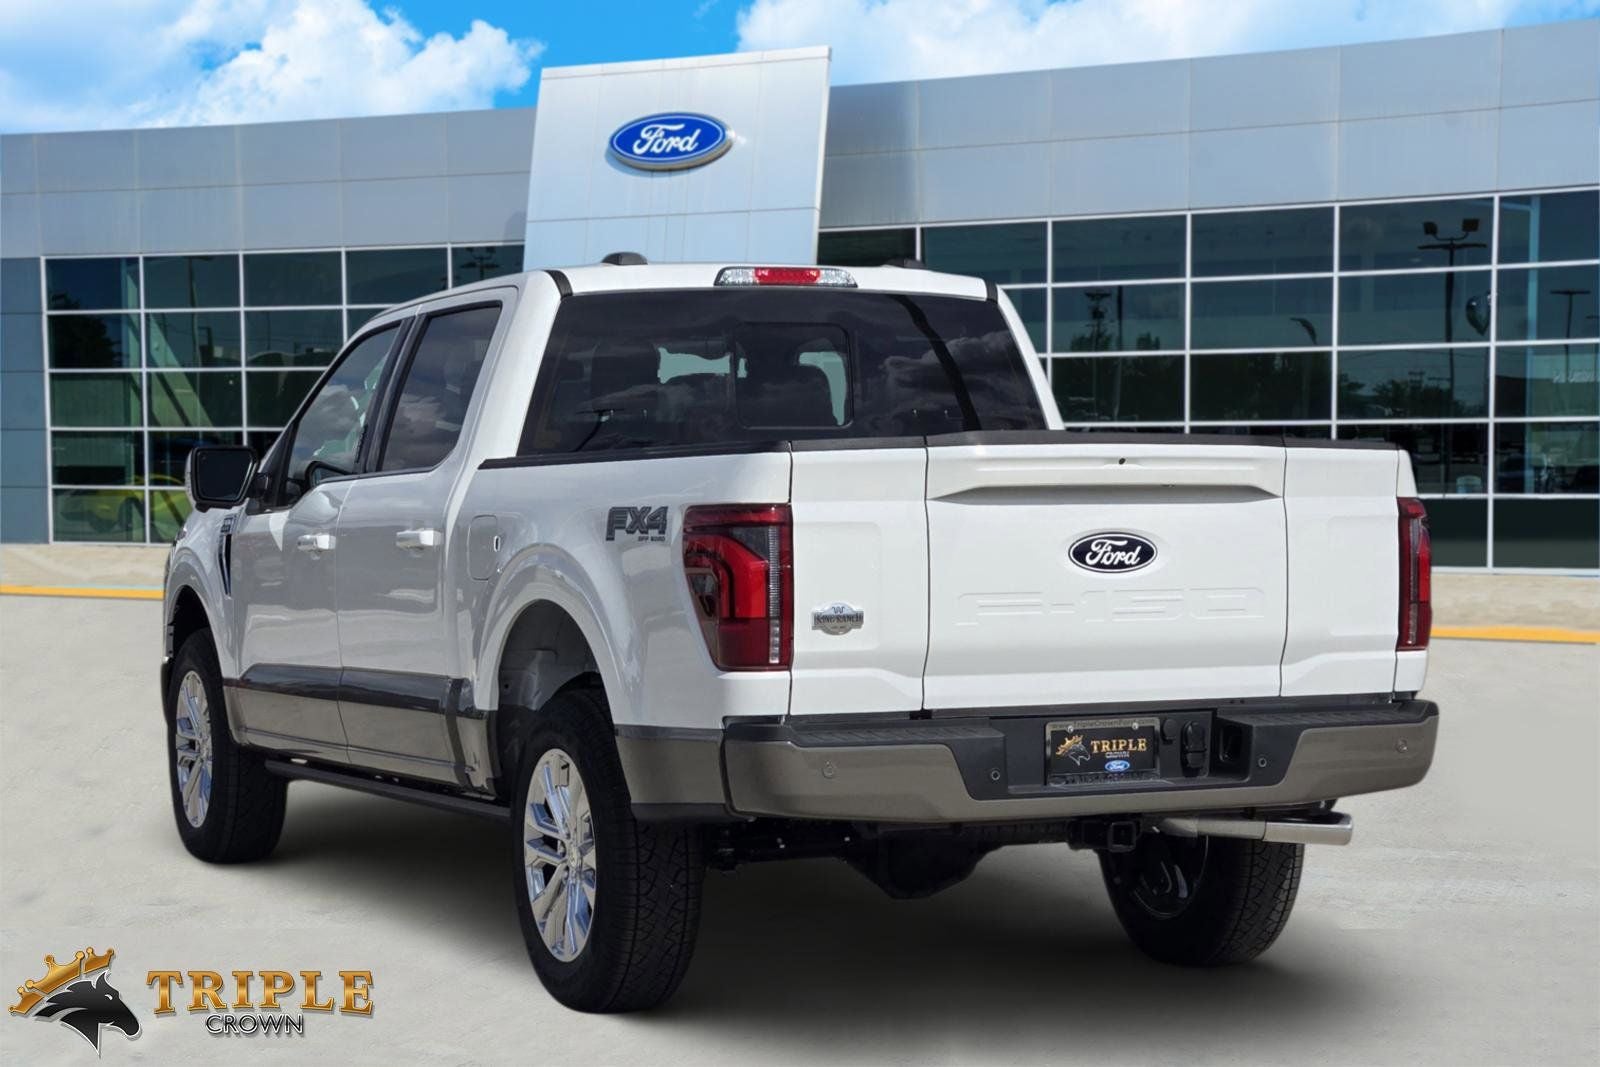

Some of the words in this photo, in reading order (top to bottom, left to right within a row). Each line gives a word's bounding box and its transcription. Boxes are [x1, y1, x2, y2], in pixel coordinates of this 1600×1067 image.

[632, 123, 702, 155] Ford
[605, 505, 669, 541] FX4
[1085, 538, 1142, 566] Ford
[1090, 738, 1148, 754] TRIPLE
